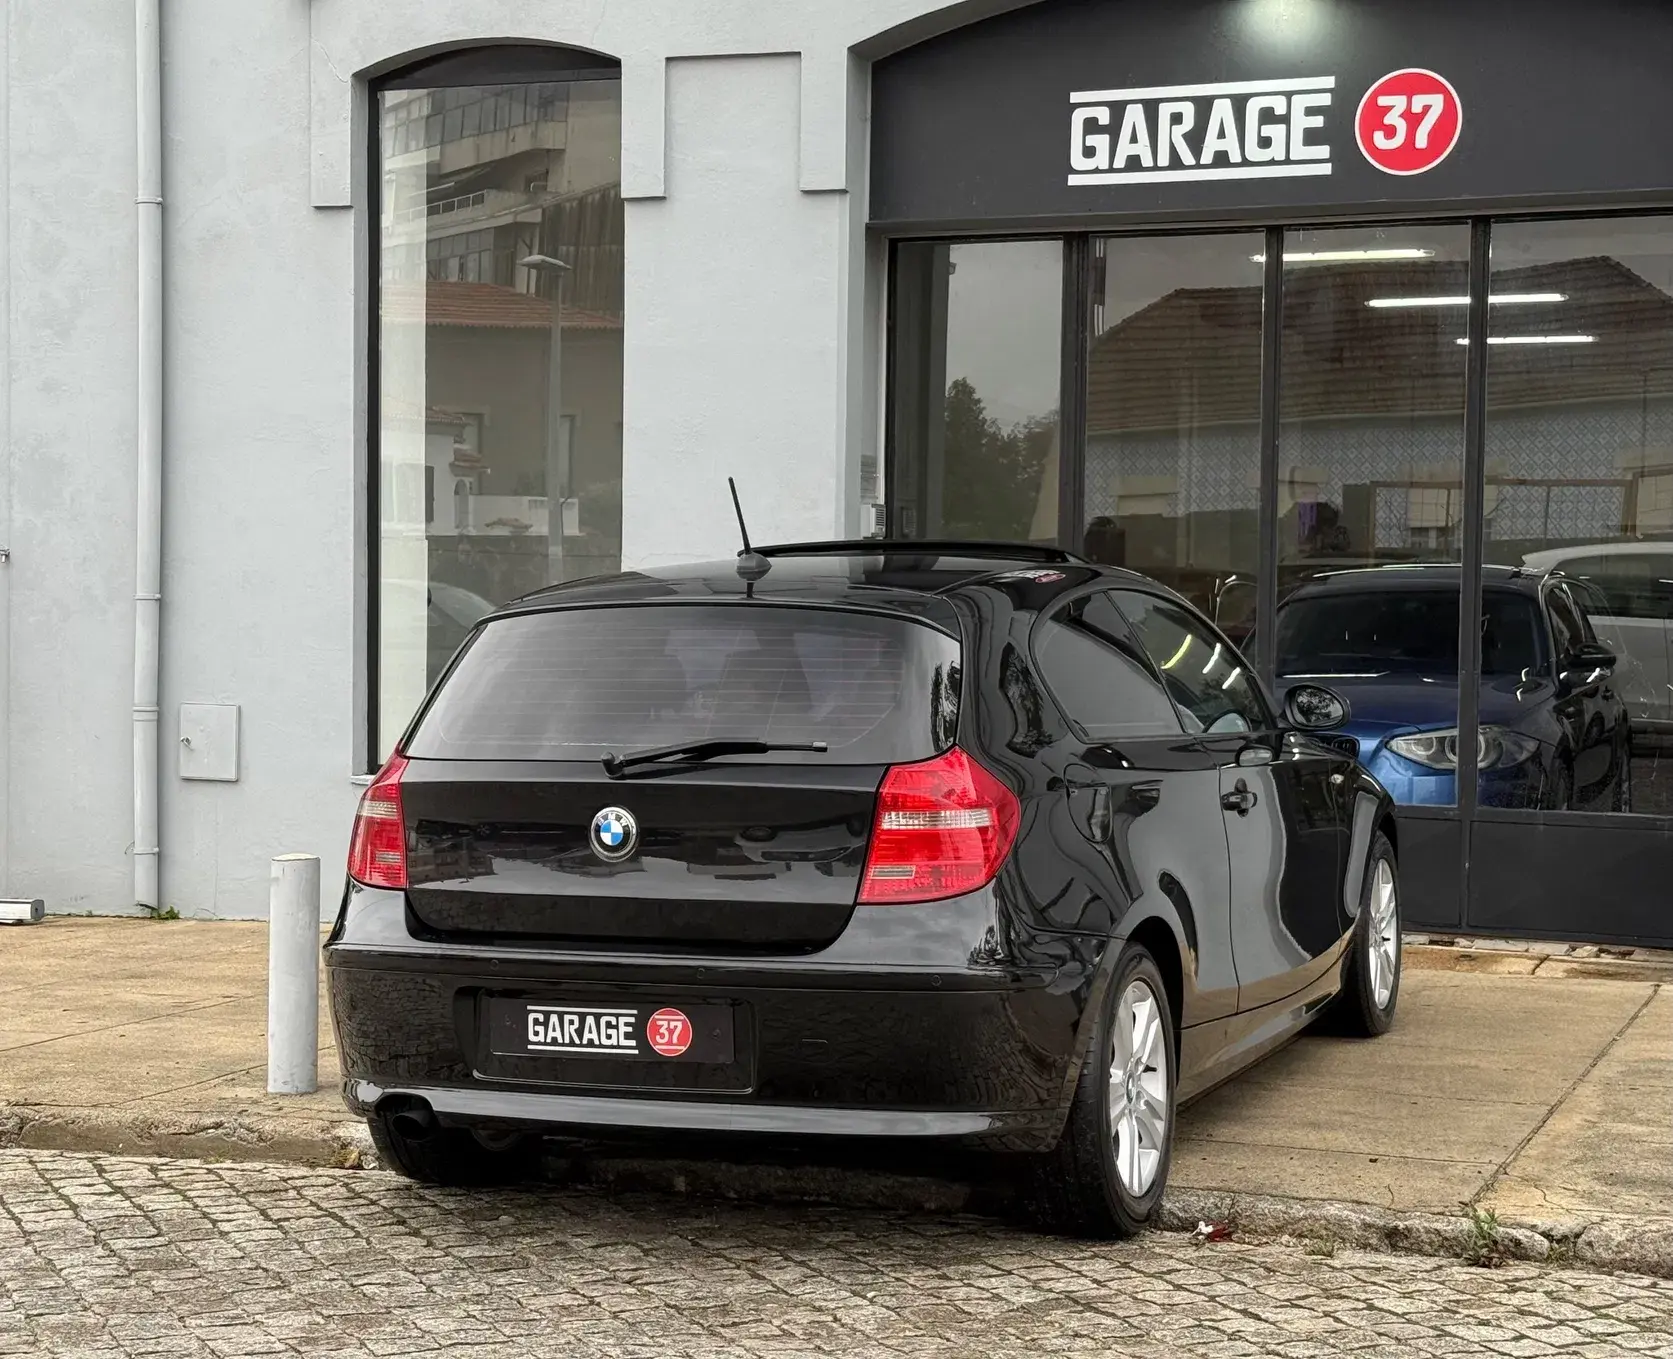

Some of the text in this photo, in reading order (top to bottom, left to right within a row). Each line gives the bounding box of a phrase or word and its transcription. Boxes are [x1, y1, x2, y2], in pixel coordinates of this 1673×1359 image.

[1070, 92, 1444, 171] GARAGE 37
[527, 1012, 683, 1047] GARAGE 37
